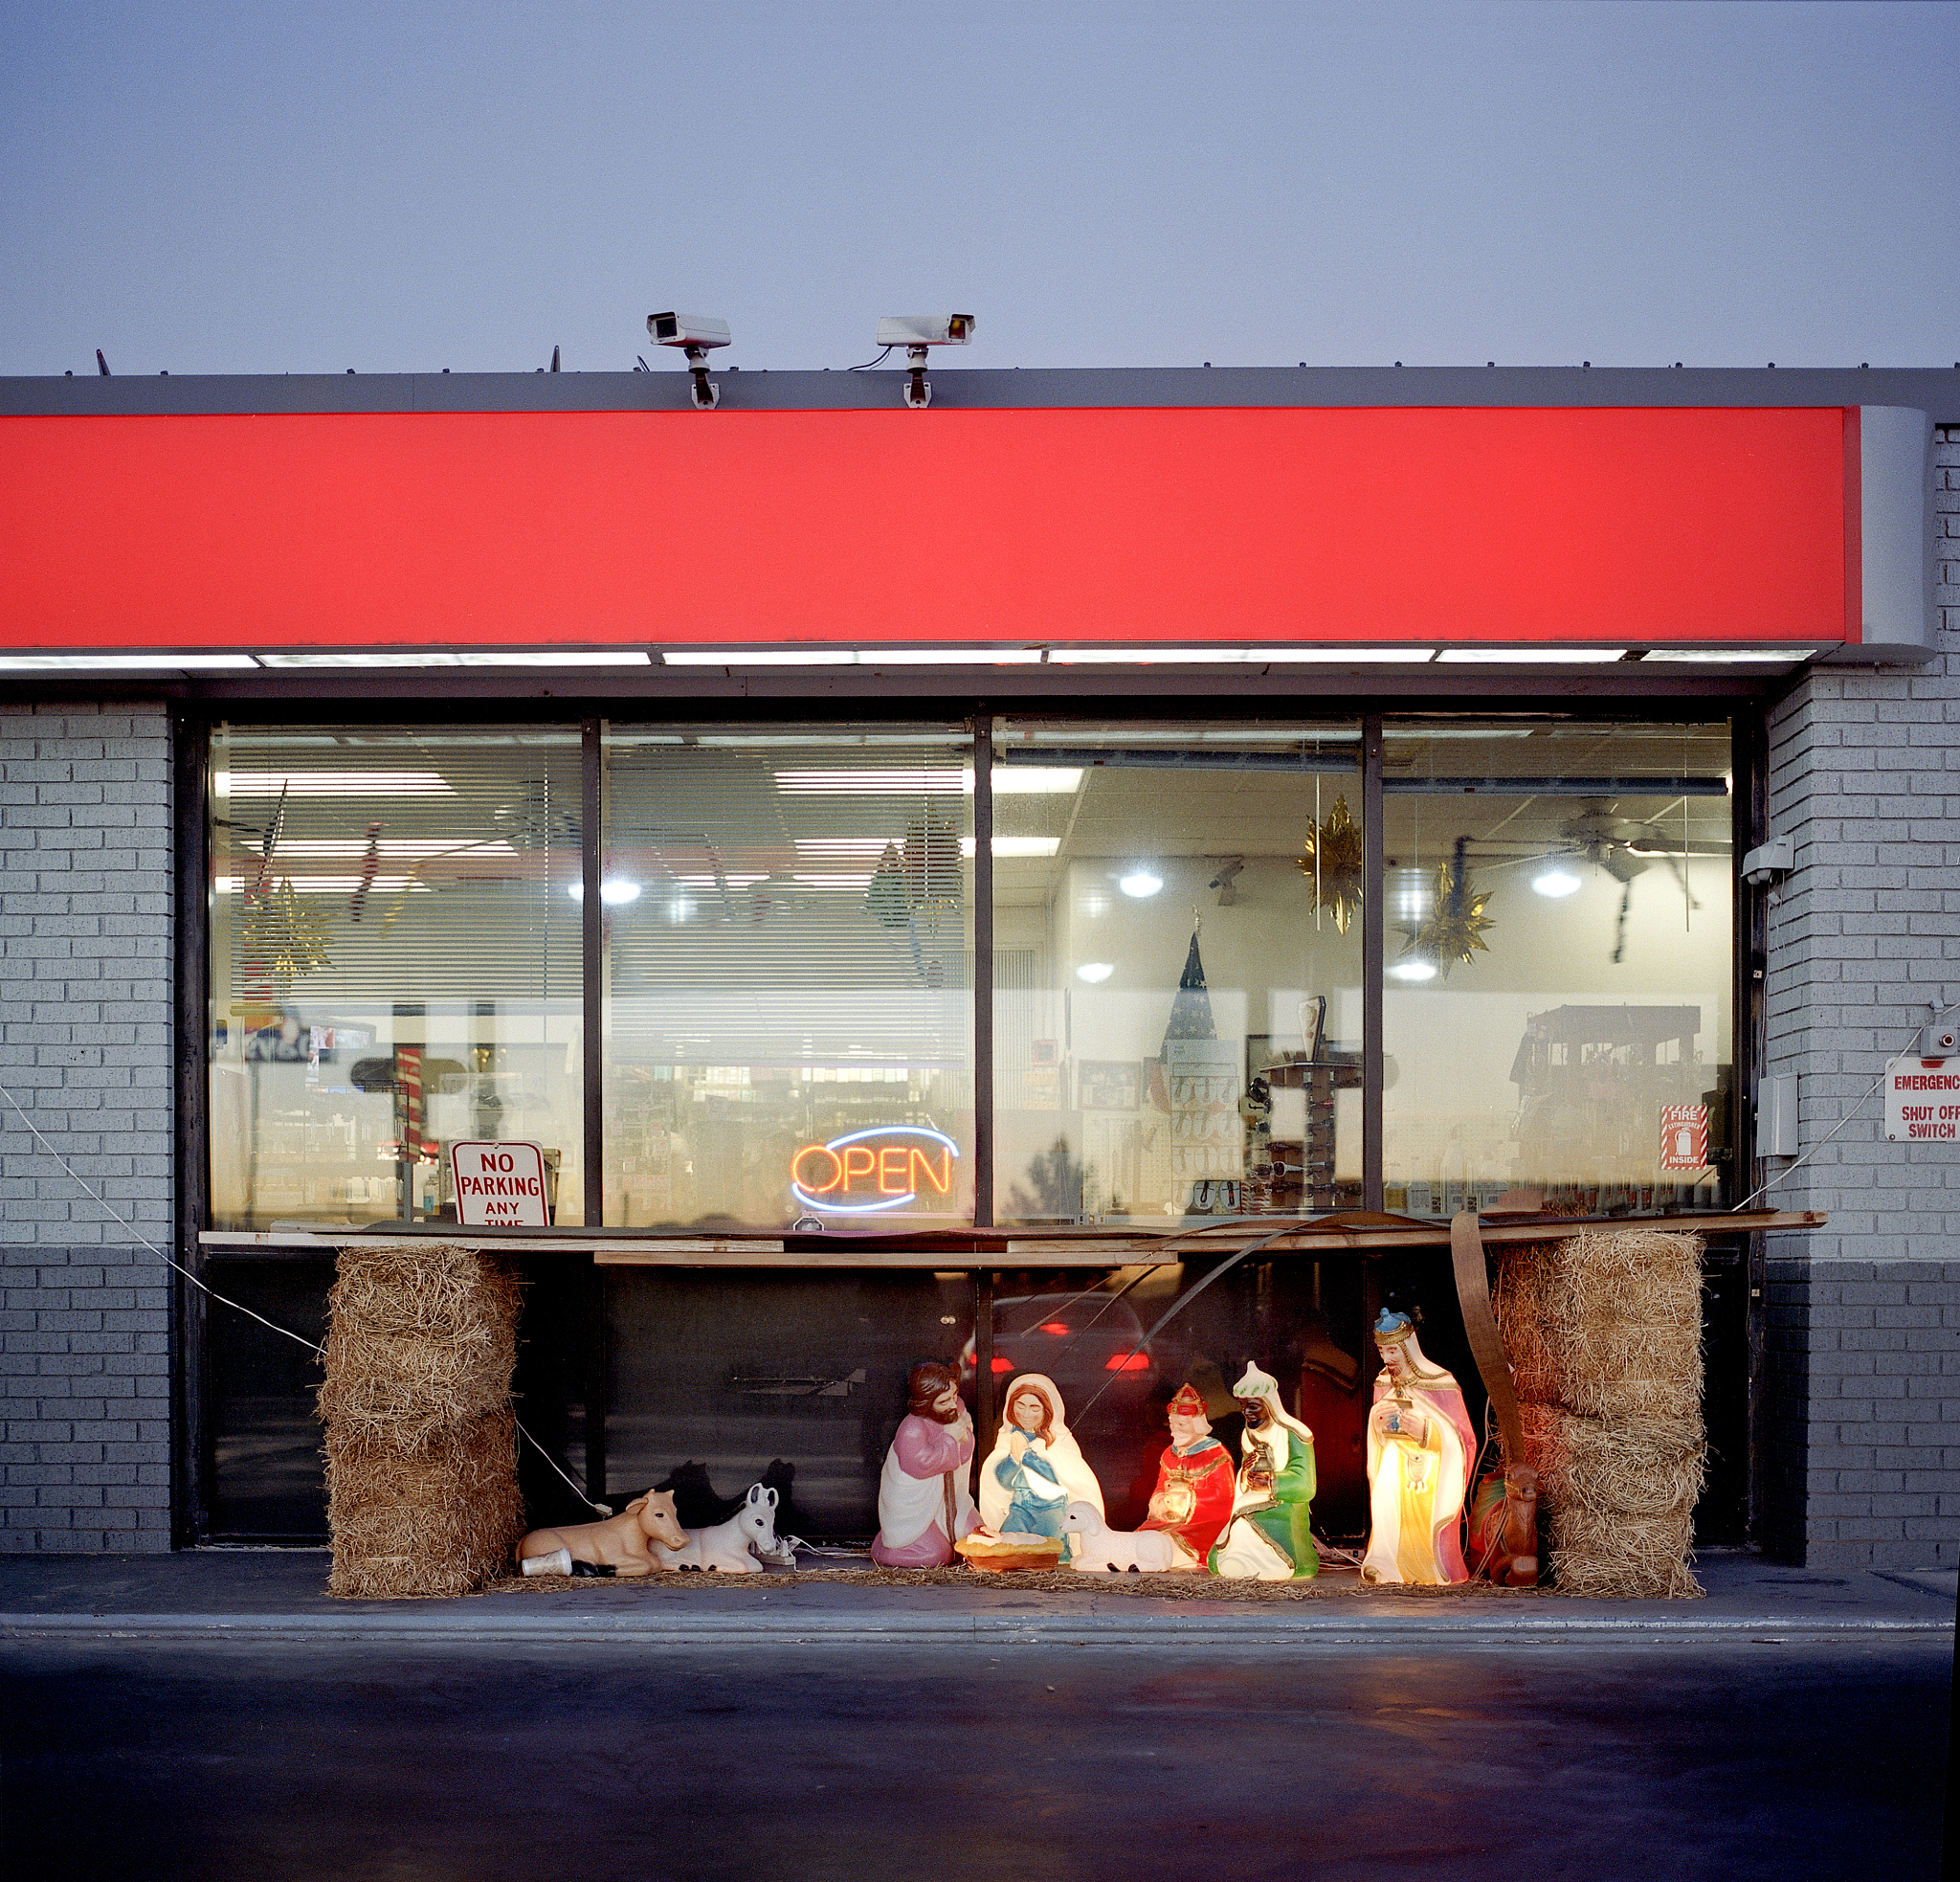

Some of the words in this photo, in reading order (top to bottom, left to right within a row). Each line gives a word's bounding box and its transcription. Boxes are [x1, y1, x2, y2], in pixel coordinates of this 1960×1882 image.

[1671, 1110, 1697, 1121] FIRE
[1902, 1106, 1934, 1121] SHUT
[1939, 1106, 1960, 1120] OFF
[1908, 1123, 1955, 1138] SWITCH
[480, 1154, 514, 1173] NO
[1669, 1155, 1699, 1164] INSIDE
[791, 1144, 951, 1195] OPEN
[460, 1176, 539, 1197] PARKING
[485, 1201, 519, 1215] ANY
